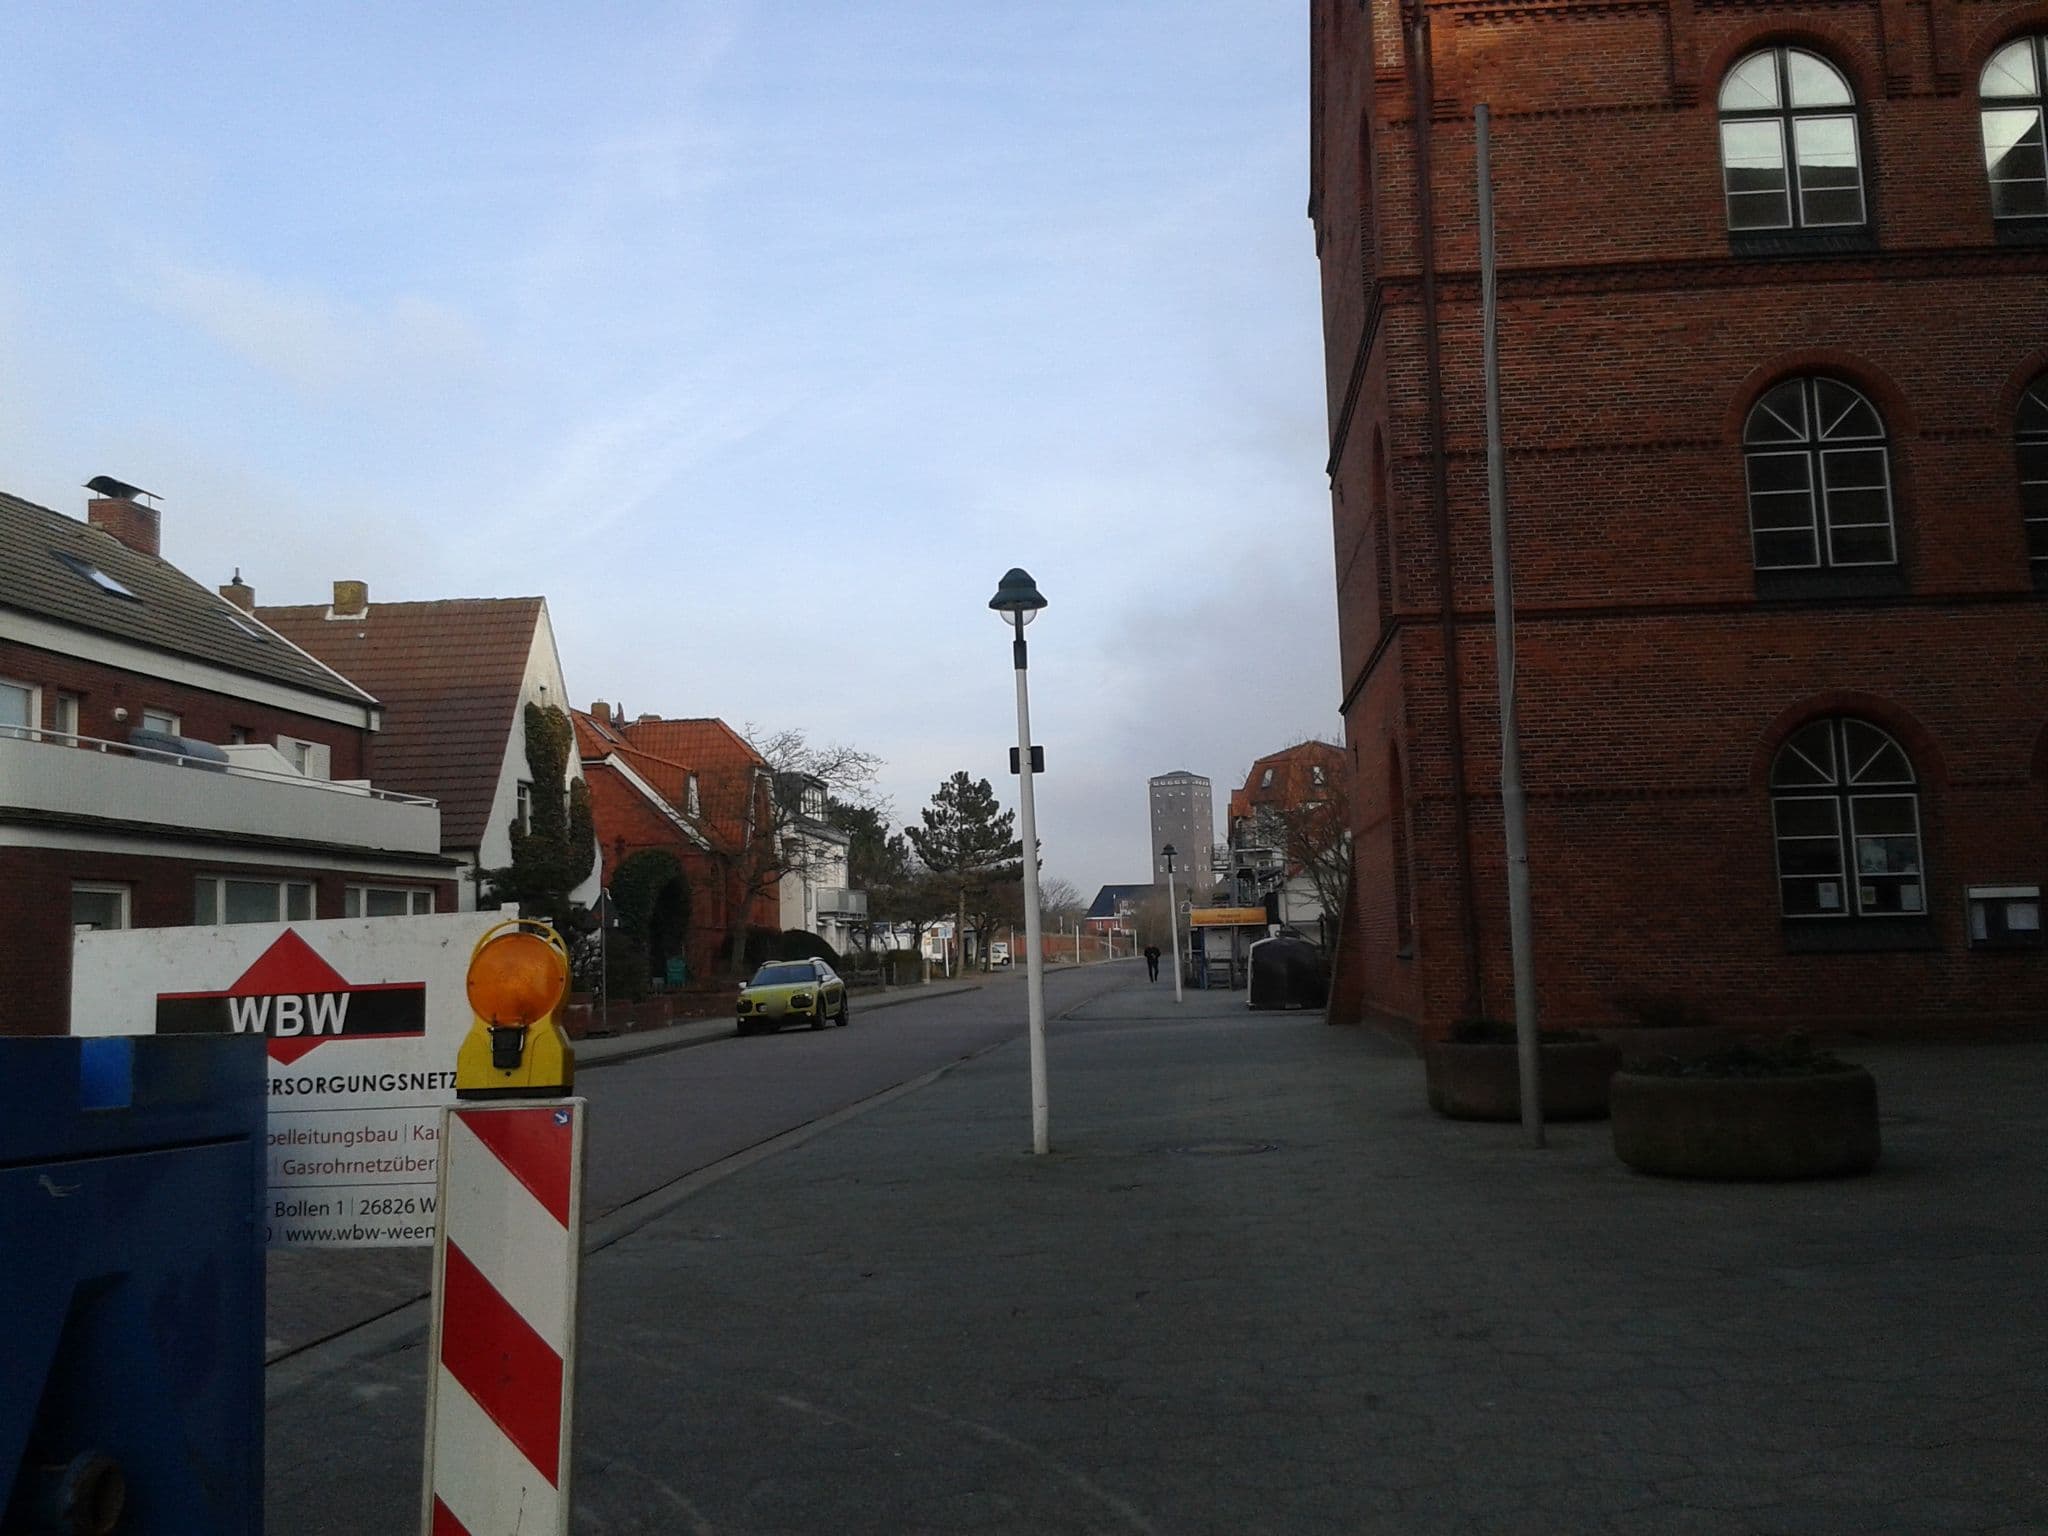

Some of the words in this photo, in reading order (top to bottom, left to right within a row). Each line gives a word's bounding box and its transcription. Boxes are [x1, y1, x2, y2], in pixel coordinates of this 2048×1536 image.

[229, 992, 351, 1037] WBW
[283, 1155, 438, 1175] Gasrohrnetzüber
[275, 1200, 330, 1217] Bollen
[337, 1201, 344, 1216] 1
[359, 1198, 415, 1215] 26826
[286, 1223, 436, 1242] www.wbw-ween
